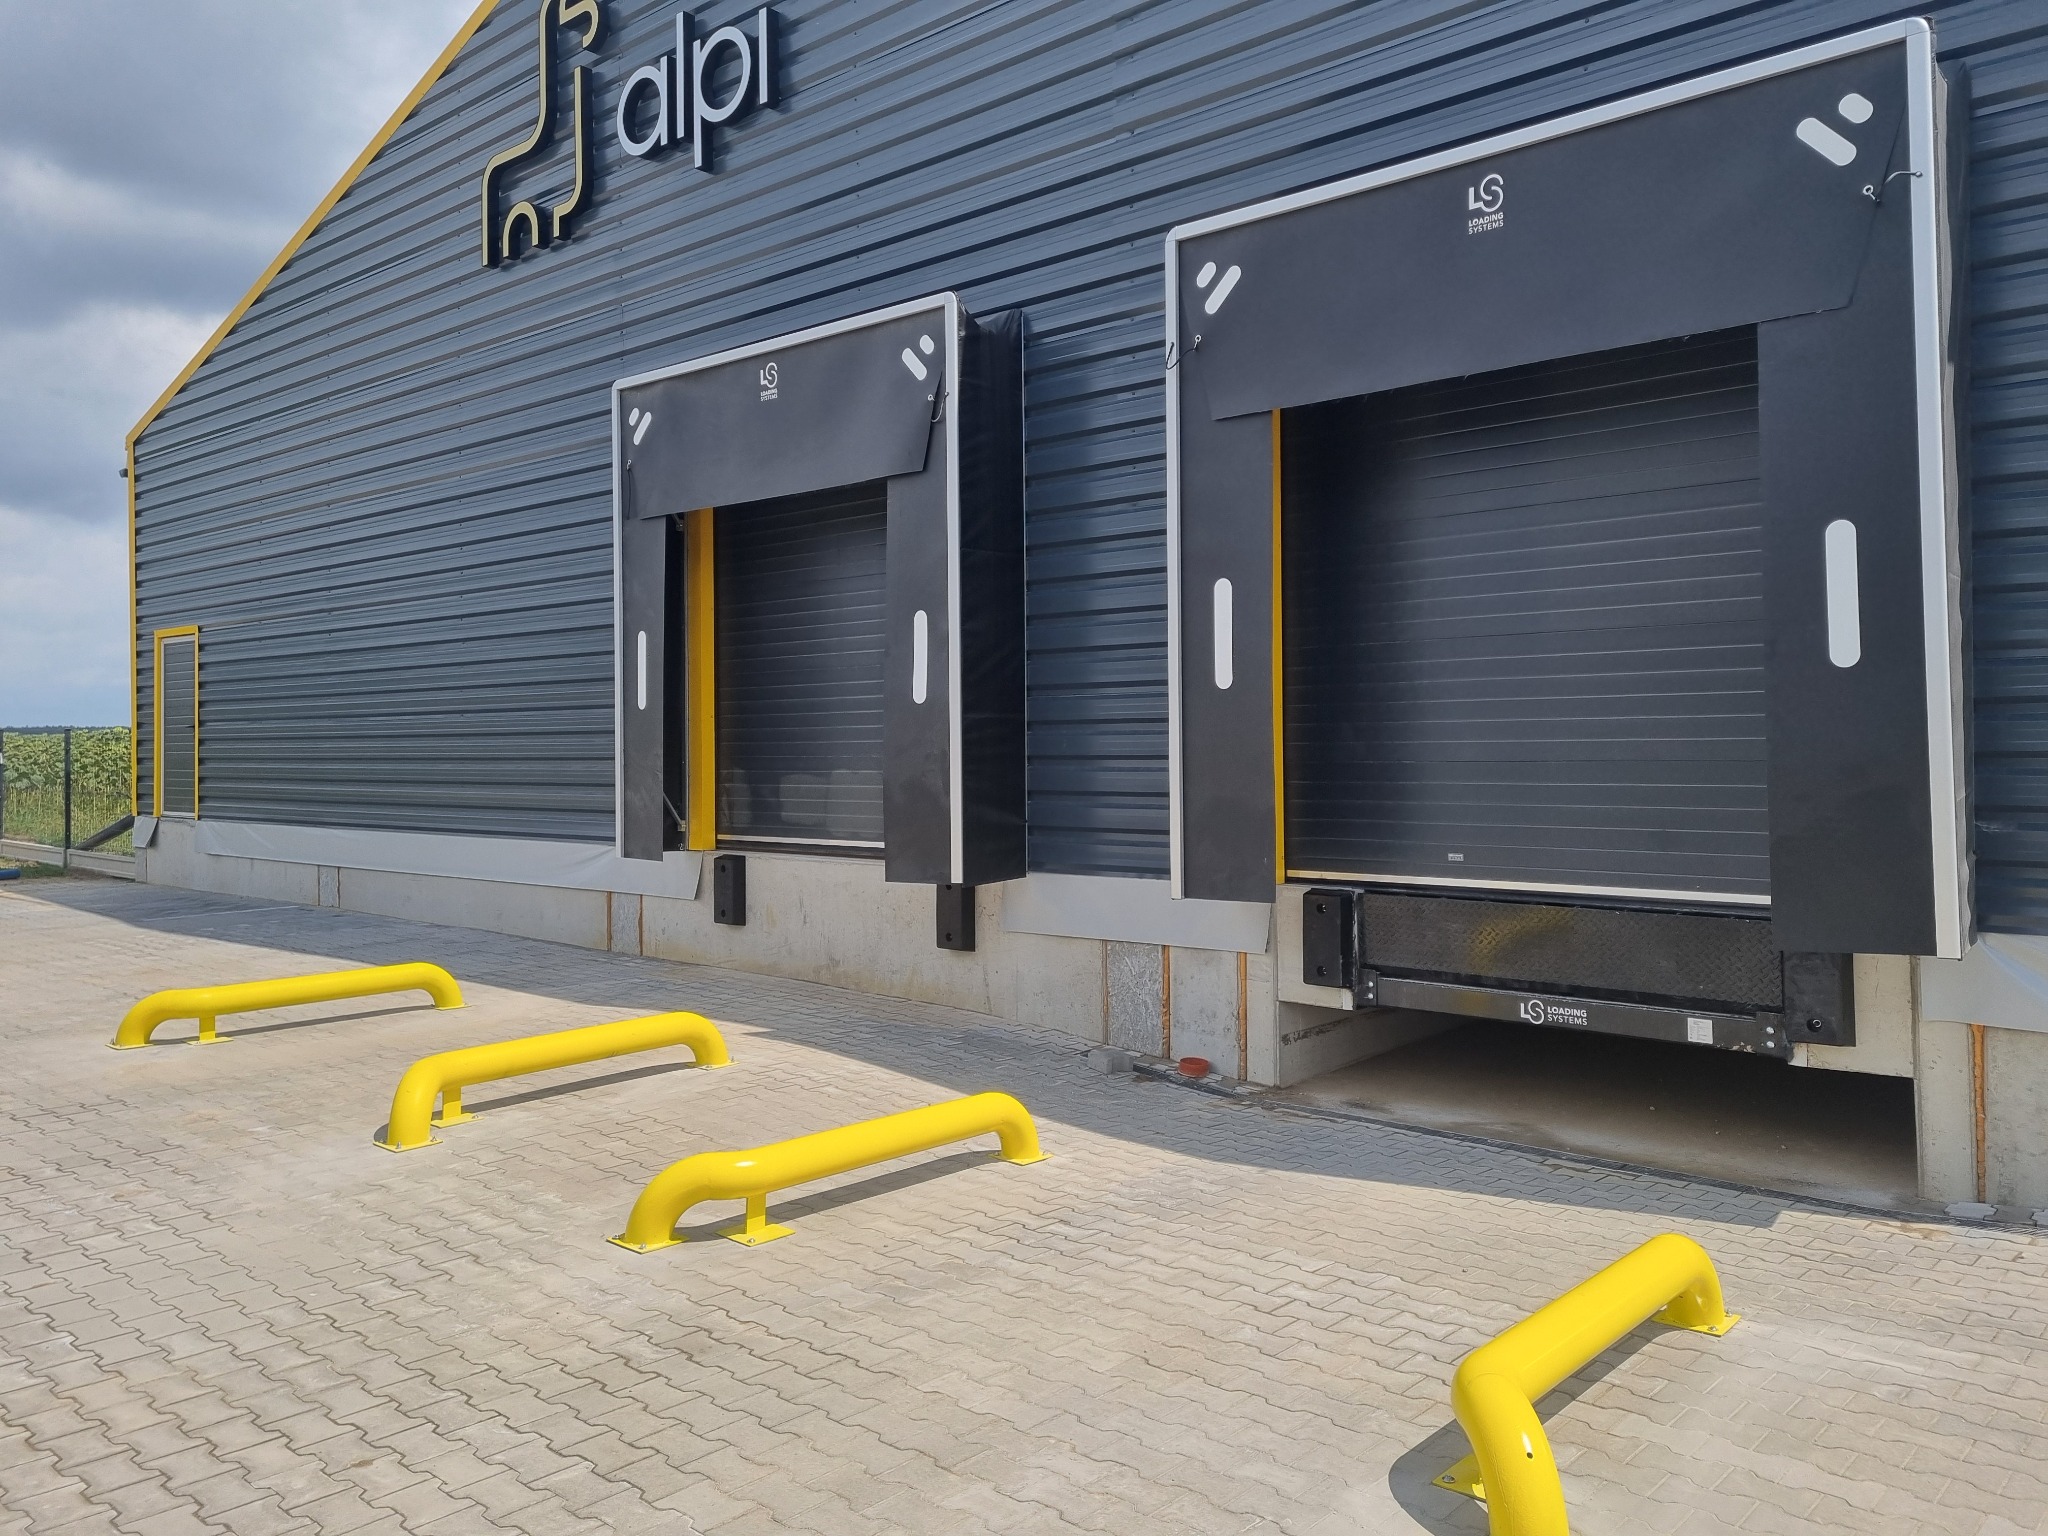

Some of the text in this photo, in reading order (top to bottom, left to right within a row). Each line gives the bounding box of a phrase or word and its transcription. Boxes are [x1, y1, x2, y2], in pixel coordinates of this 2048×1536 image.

[1468, 212, 1504, 227] LOADING
[1468, 220, 1504, 235] SYSTEMS
[1547, 1006, 1587, 1017] LOADING
[1547, 1014, 1588, 1026] SYSTEMS
